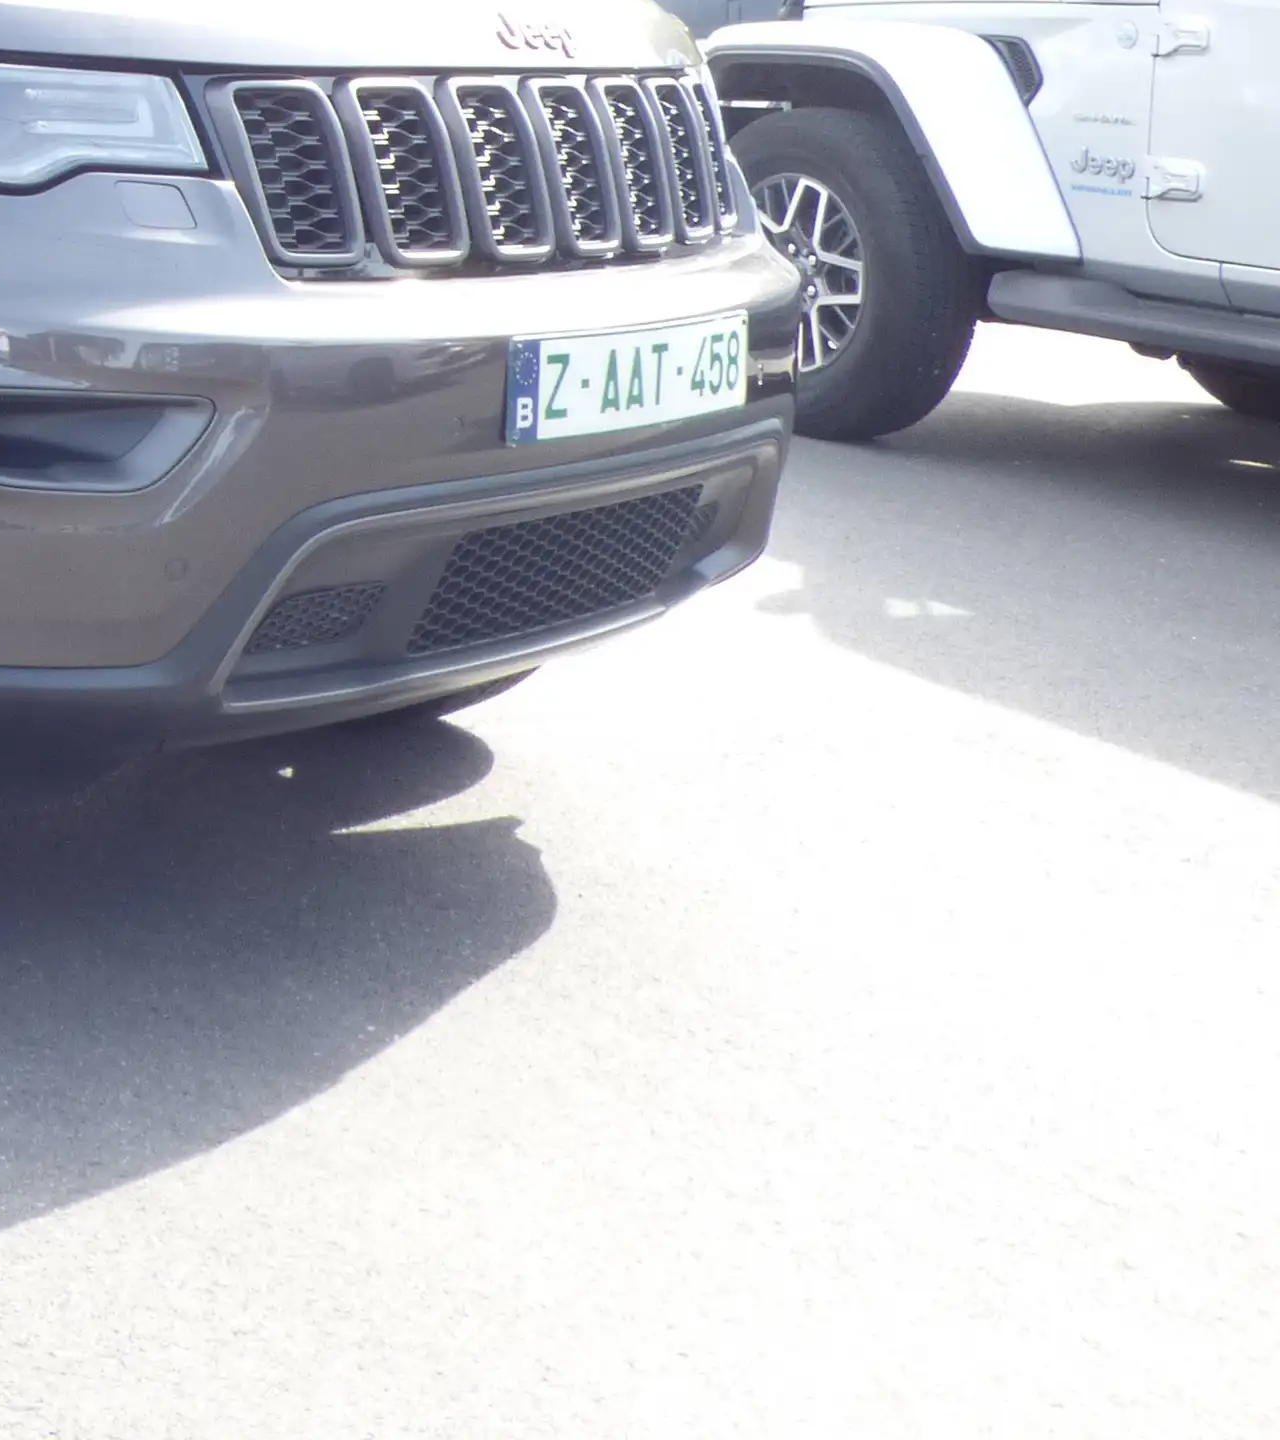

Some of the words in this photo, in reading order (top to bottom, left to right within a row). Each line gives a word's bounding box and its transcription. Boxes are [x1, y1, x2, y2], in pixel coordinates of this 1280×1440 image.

[495, 10, 577, 60] Jeep
[1070, 147, 1136, 184] Jeep
[516, 396, 534, 429] B
